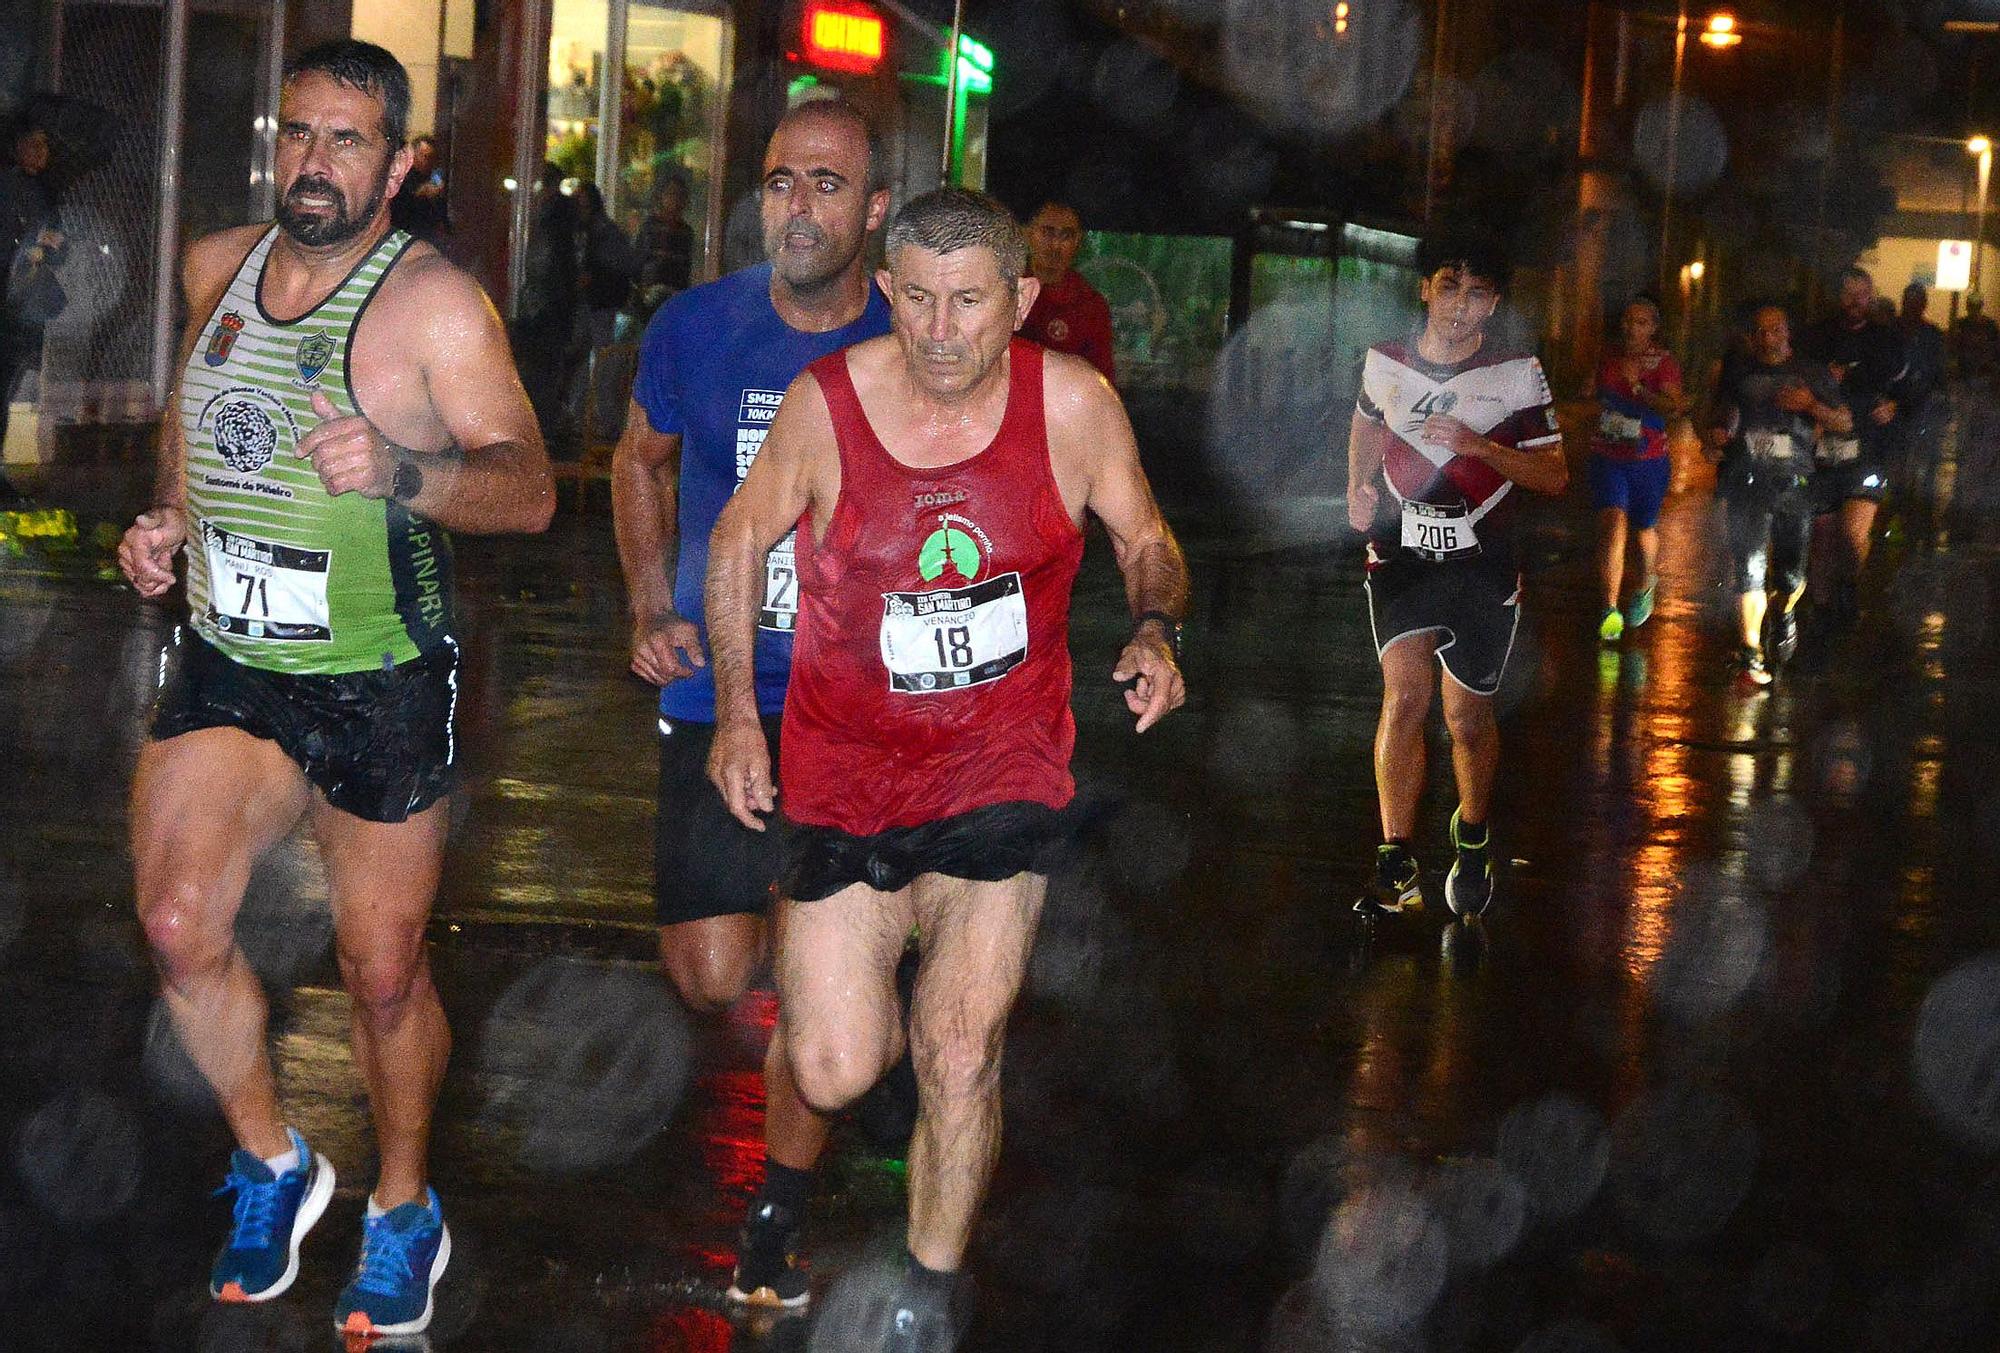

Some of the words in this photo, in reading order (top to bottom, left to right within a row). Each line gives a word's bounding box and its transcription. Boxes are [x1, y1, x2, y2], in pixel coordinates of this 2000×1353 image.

[747, 393, 784, 406] SM22
[241, 481, 254, 491] de
[1417, 523, 1457, 549] 206
[236, 572, 269, 617] 71
[917, 601, 935, 615] SAN
[923, 611, 976, 626] VENANCIO
[935, 625, 973, 668] 18
